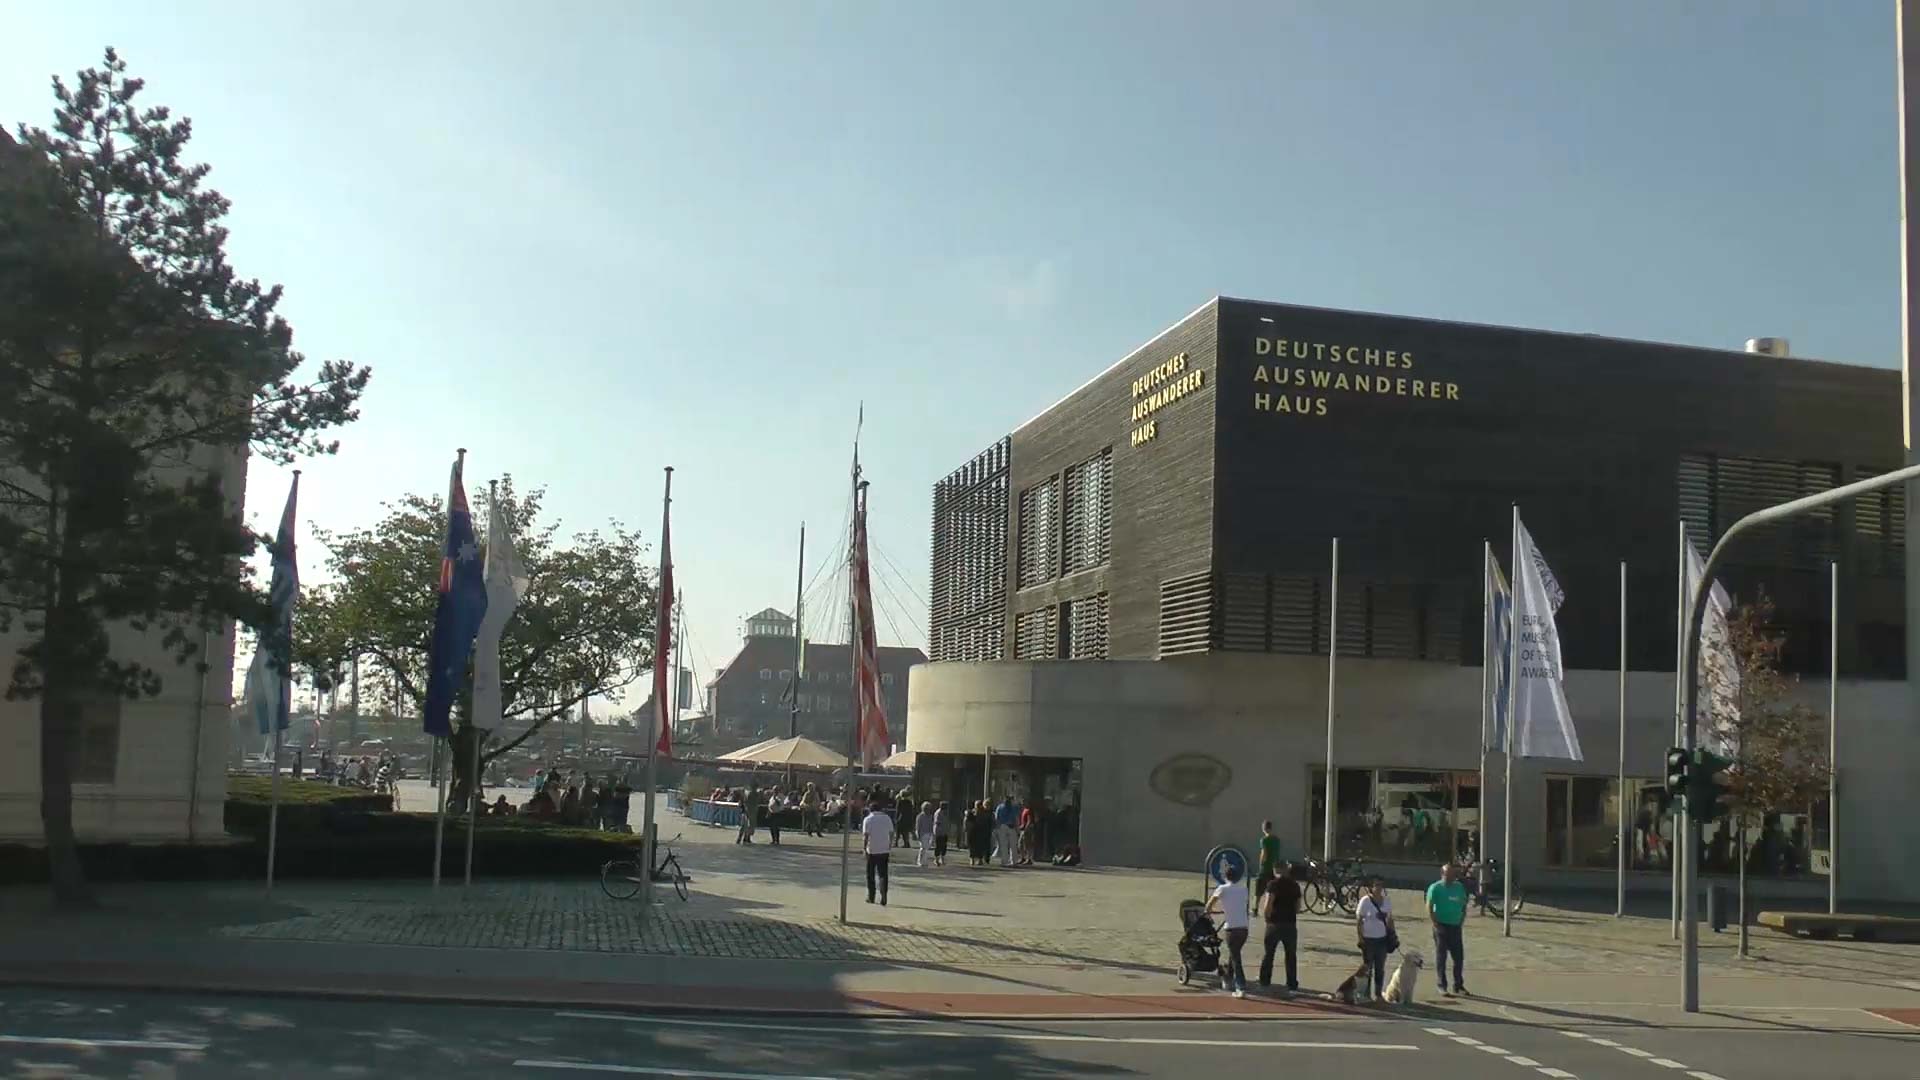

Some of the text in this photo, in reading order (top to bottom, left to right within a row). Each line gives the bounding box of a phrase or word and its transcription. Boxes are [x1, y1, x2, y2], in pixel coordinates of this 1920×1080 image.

[1255, 337, 1413, 369] DEUTSCHES
[1132, 352, 1186, 397] DEUTSCHES
[1254, 365, 1460, 400] AUSWANDERER
[1131, 369, 1202, 422] AUSWANDERER
[1254, 393, 1328, 416] HAUS
[1131, 420, 1156, 446] HAUS
[1521, 649, 1535, 661] OF
